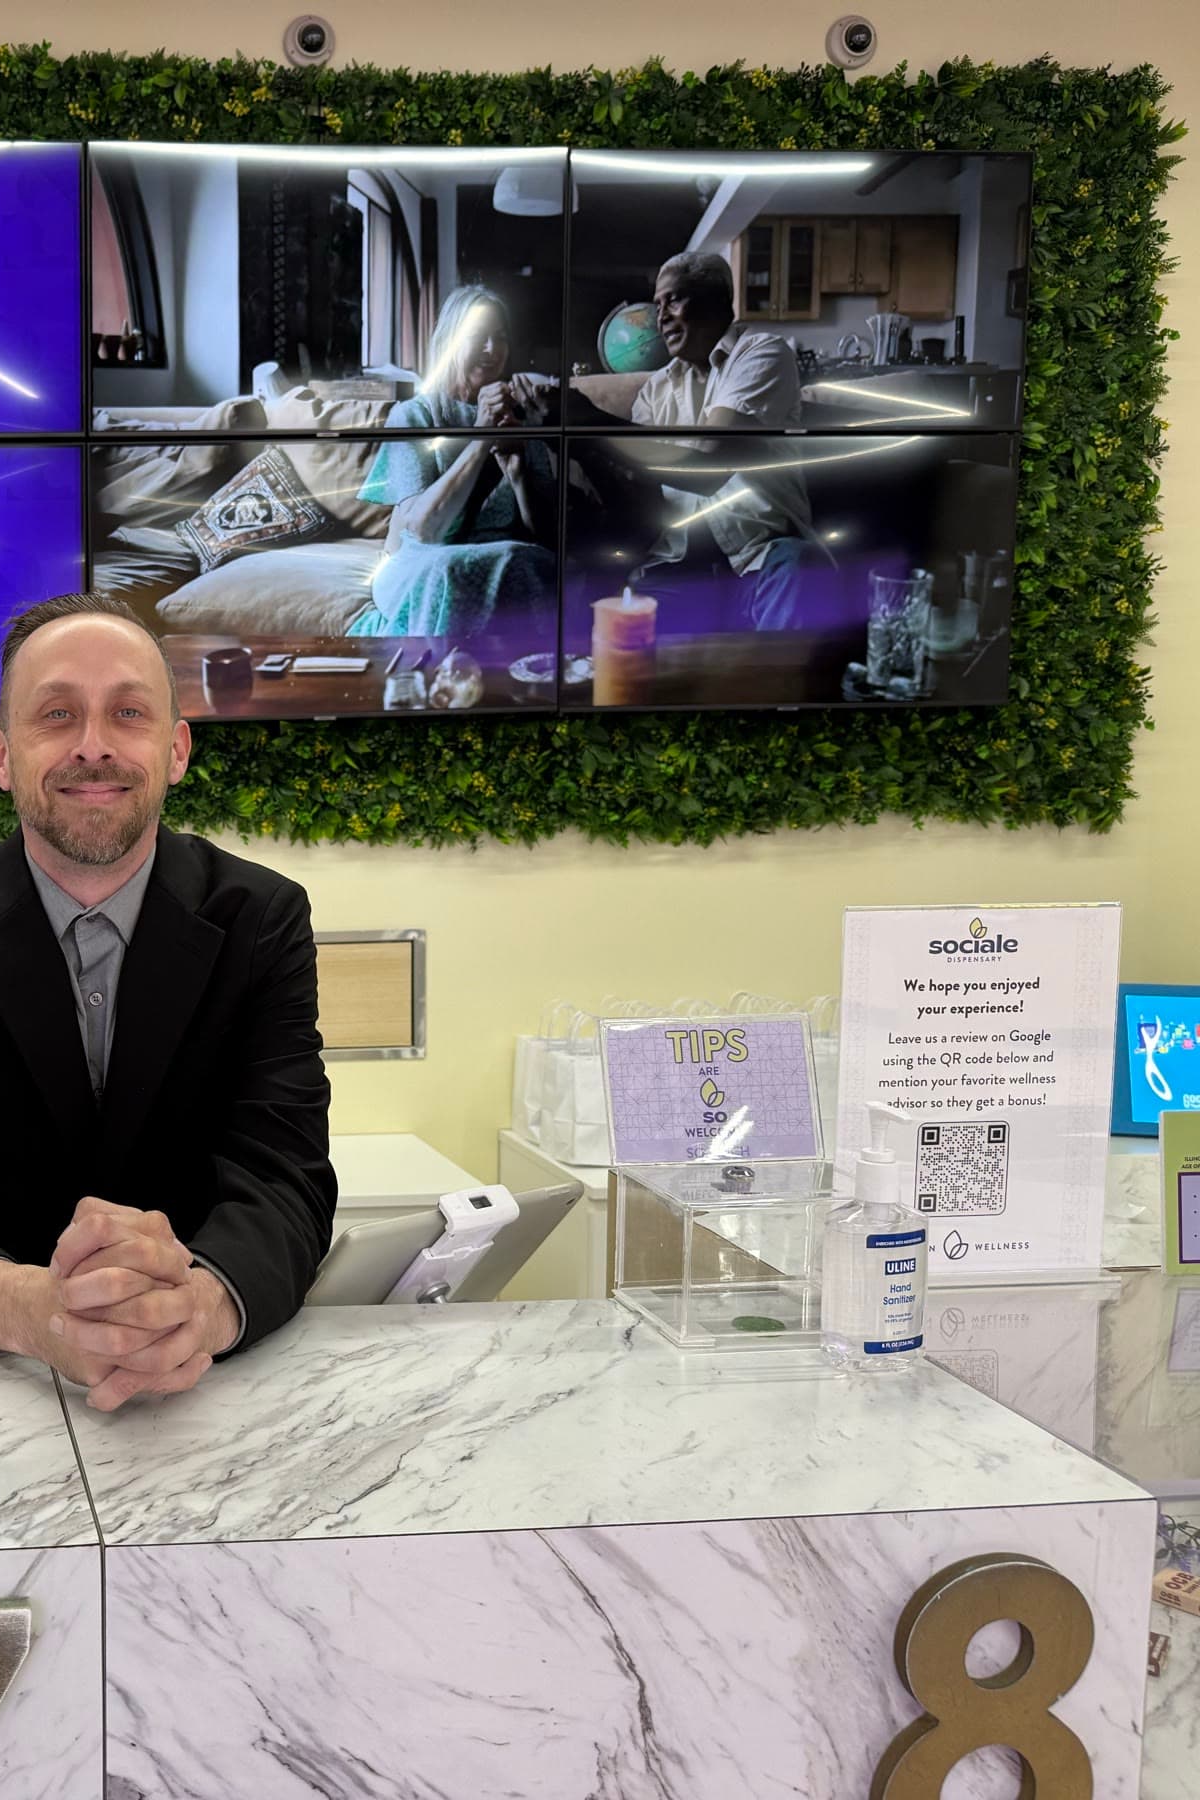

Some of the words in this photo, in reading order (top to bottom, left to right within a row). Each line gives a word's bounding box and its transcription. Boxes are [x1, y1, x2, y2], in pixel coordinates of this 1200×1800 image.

[928, 934, 1019, 955] sociale
[947, 956, 1002, 964] DISPENSARY
[904, 978, 926, 992] We
[928, 978, 960, 996] hope
[964, 981, 987, 996] you
[990, 976, 1040, 995] enjoyed
[917, 1005, 947, 1019] your
[950, 1001, 1024, 1018] experience!
[665, 1028, 749, 1064] TIPS
[888, 1033, 922, 1044] Leave
[925, 1036, 938, 1044] us
[941, 1035, 947, 1044] a
[950, 1032, 988, 1043] review
[992, 1034, 1006, 1042] on
[1010, 1029, 1051, 1046] Google
[882, 1054, 914, 1070] using
[917, 1053, 936, 1065] the
[940, 1052, 962, 1068] QR
[965, 1052, 992, 1064] code
[996, 1052, 1030, 1064] below
[1032, 1050, 1054, 1062] and
[698, 1066, 720, 1076] ARE
[878, 1076, 928, 1088] mention
[931, 1078, 958, 1091] your
[960, 1074, 1006, 1086] favorite
[1008, 1072, 1056, 1084] wellness
[888, 1097, 928, 1109] advisor
[930, 1100, 943, 1108] so
[946, 1096, 973, 1111] they
[976, 1097, 994, 1111] get
[998, 1098, 1004, 1106] a
[1008, 1094, 1046, 1106] bonus!
[703, 1111, 728, 1124] SO
[974, 1242, 1030, 1250] WELLNESS
[886, 1260, 915, 1273] ULINE
[890, 1282, 912, 1293] Hand
[883, 1294, 916, 1306] Sanitizer
[869, 1552, 1096, 1800] 8
